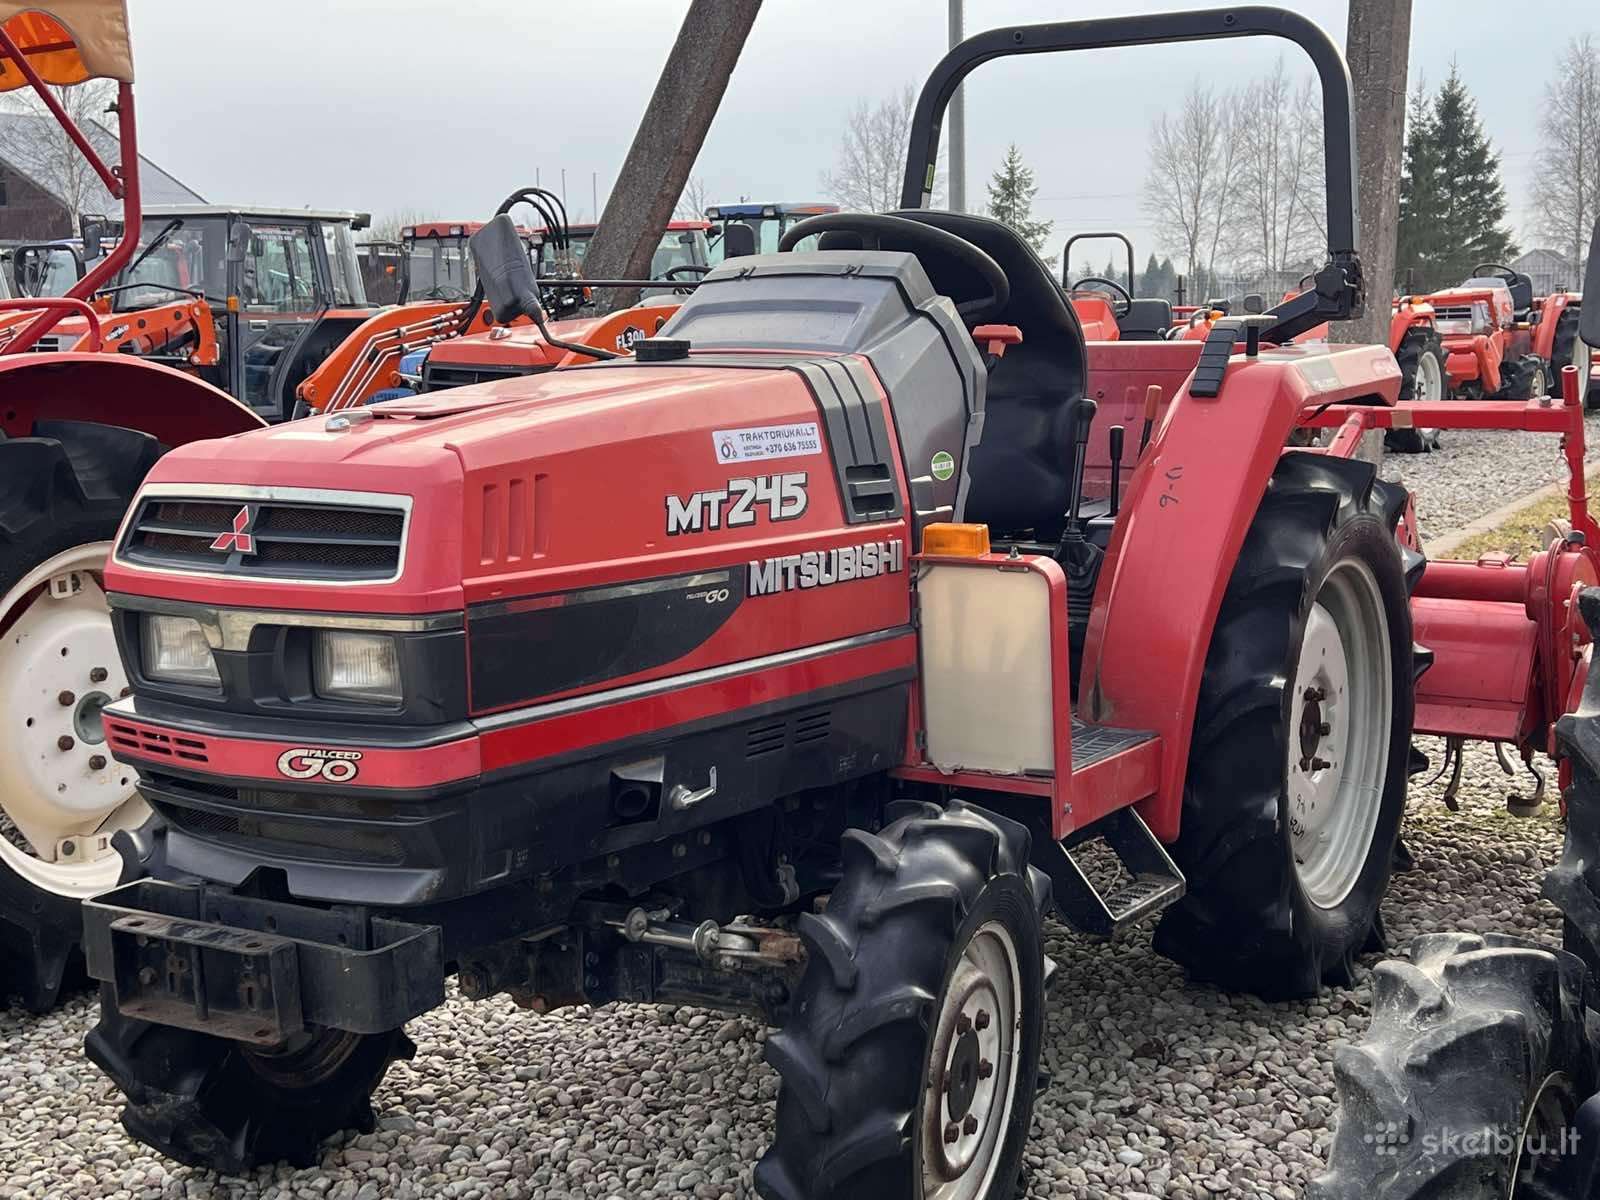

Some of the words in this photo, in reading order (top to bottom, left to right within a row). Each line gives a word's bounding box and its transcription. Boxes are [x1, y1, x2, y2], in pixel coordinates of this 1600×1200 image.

[739, 426, 816, 443] TRAKTORIUKAI.LT
[765, 443, 782, 454] +370
[783, 441, 796, 452] 636
[797, 440, 817, 450] 75555
[666, 471, 808, 536] MT245
[747, 539, 903, 598] MITSUBISHI
[705, 588, 730, 604] GO
[308, 749, 363, 761] PALCEED
